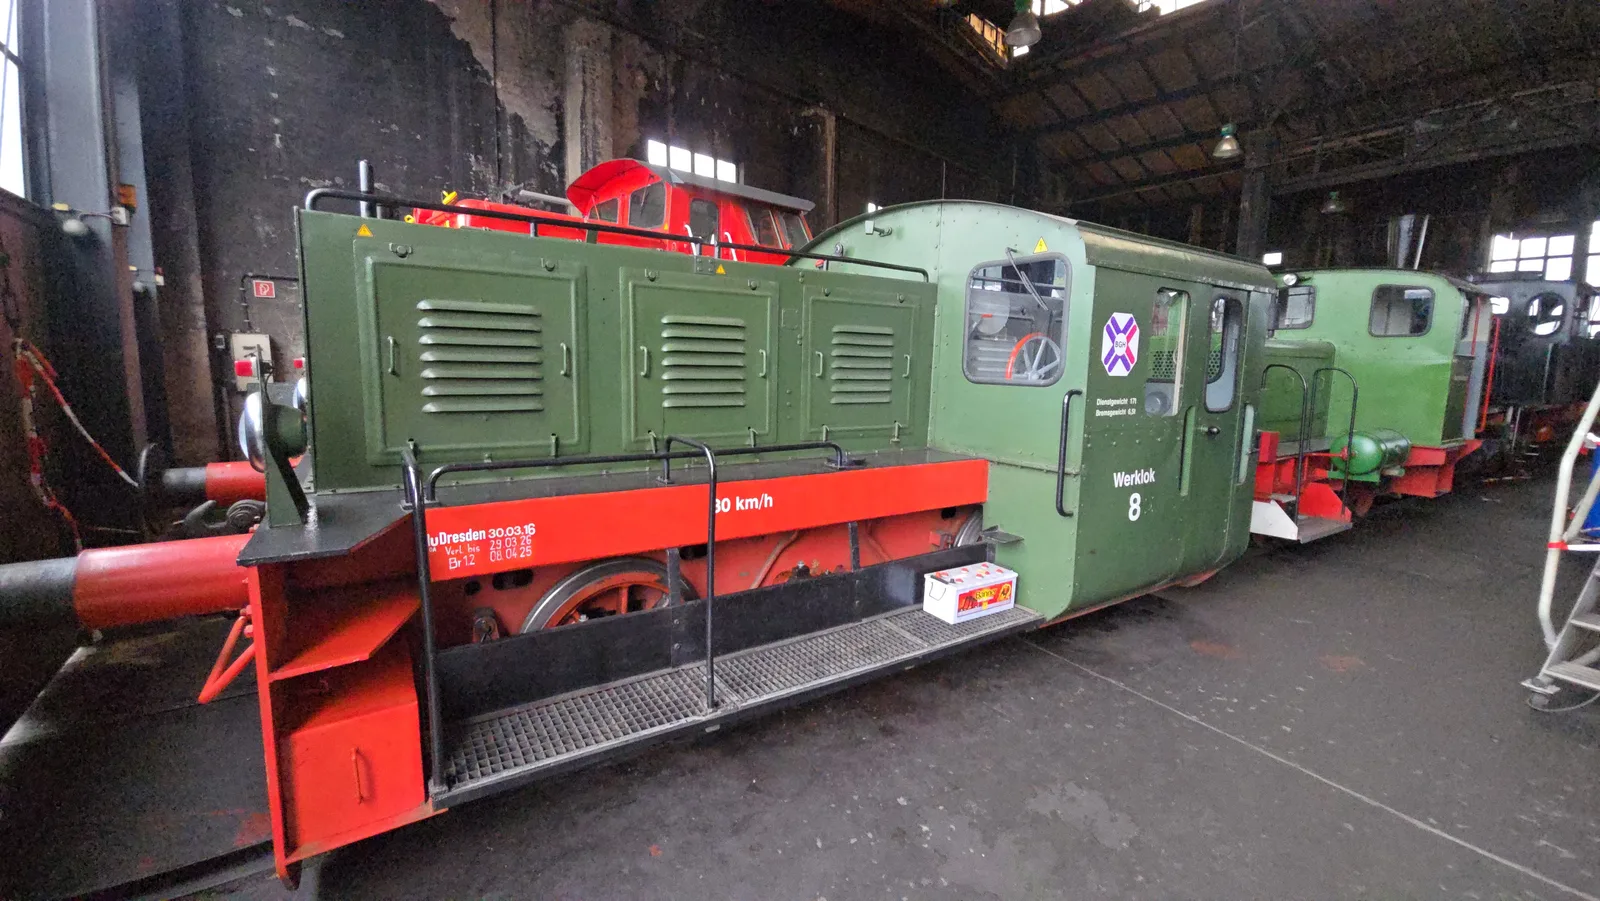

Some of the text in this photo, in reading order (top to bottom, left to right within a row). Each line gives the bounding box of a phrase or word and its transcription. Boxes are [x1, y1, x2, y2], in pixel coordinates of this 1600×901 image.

[1113, 468, 1156, 488] Werklok
[736, 493, 773, 511] km/h
[1128, 492, 1141, 522] 8
[488, 523, 536, 538] 30.03.16
